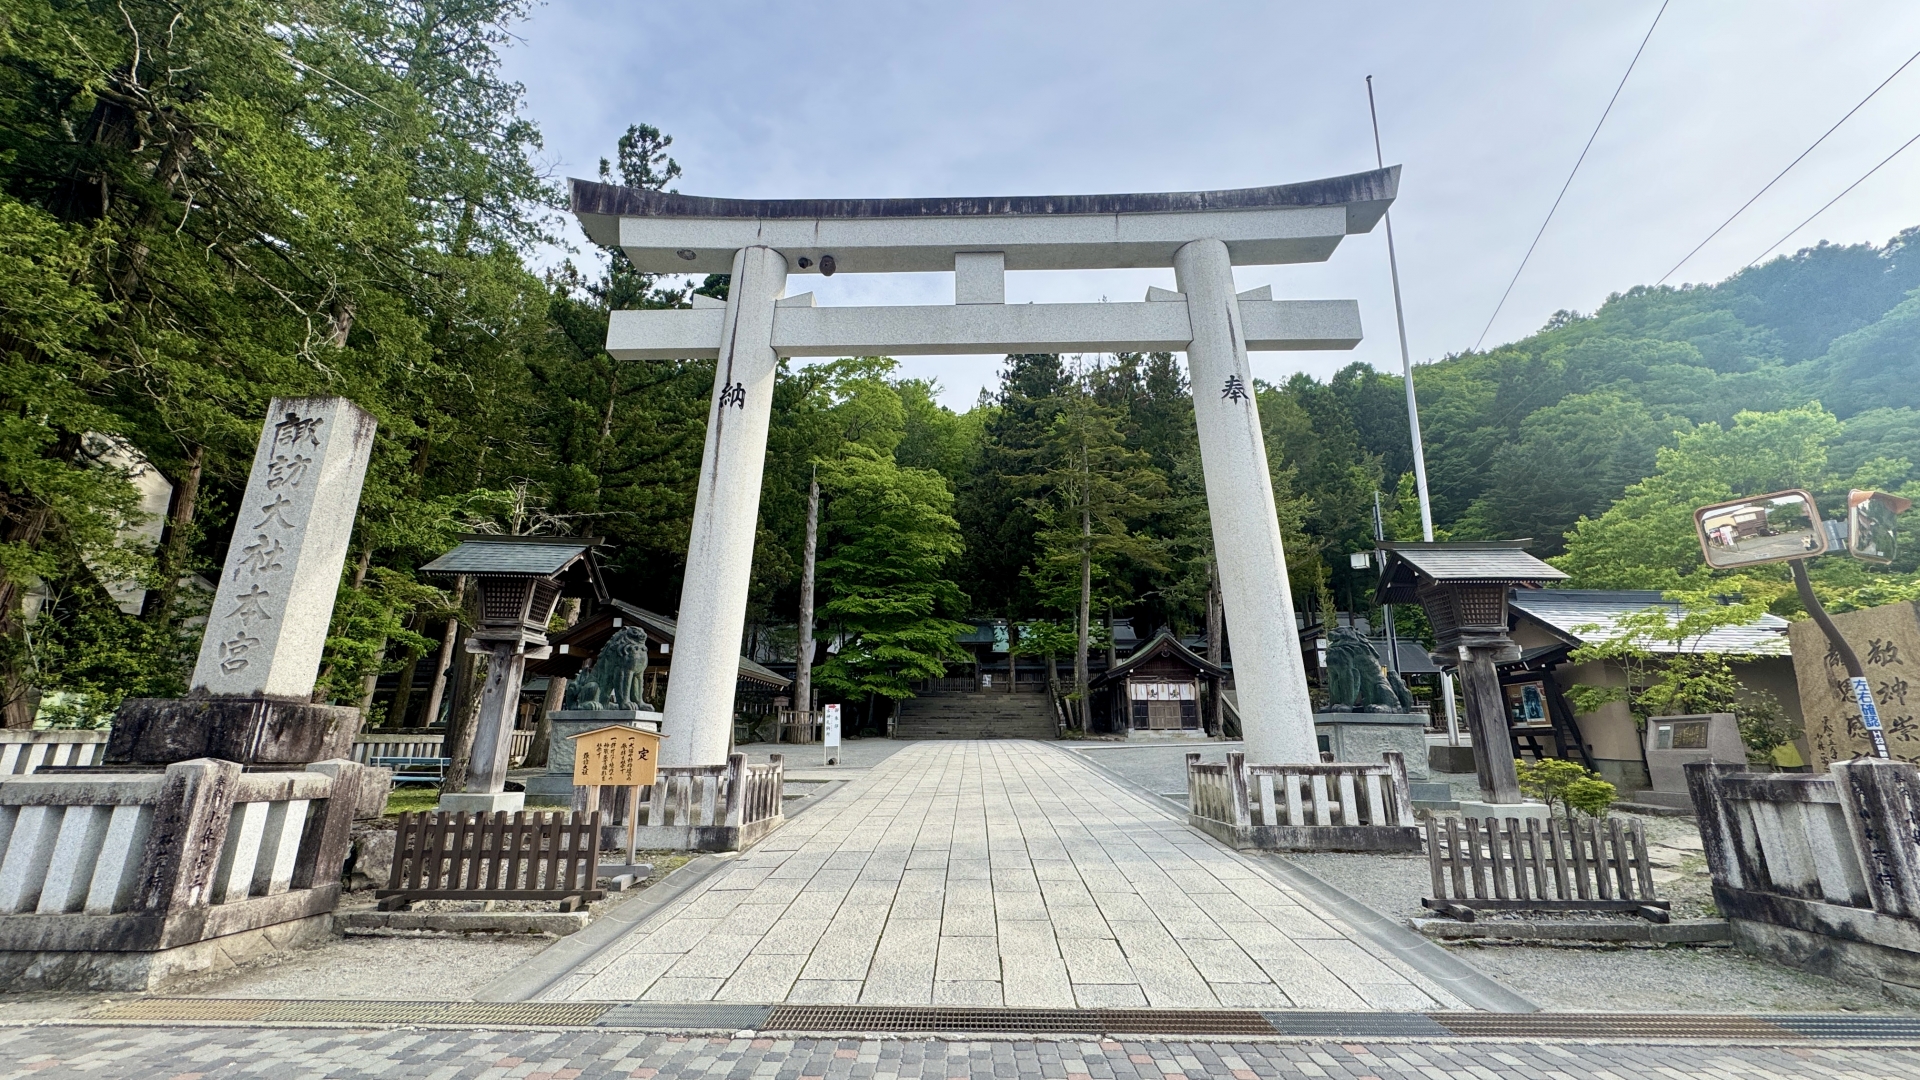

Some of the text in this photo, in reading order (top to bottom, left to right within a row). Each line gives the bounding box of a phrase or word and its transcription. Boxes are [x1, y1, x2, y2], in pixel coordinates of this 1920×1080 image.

[719, 382, 746, 410] 納
[1221, 374, 1250, 405] 奉
[218, 412, 324, 676] 諏訪大社本宮
[1853, 679, 1880, 728] 左右確認
[638, 747, 649, 761] 定
